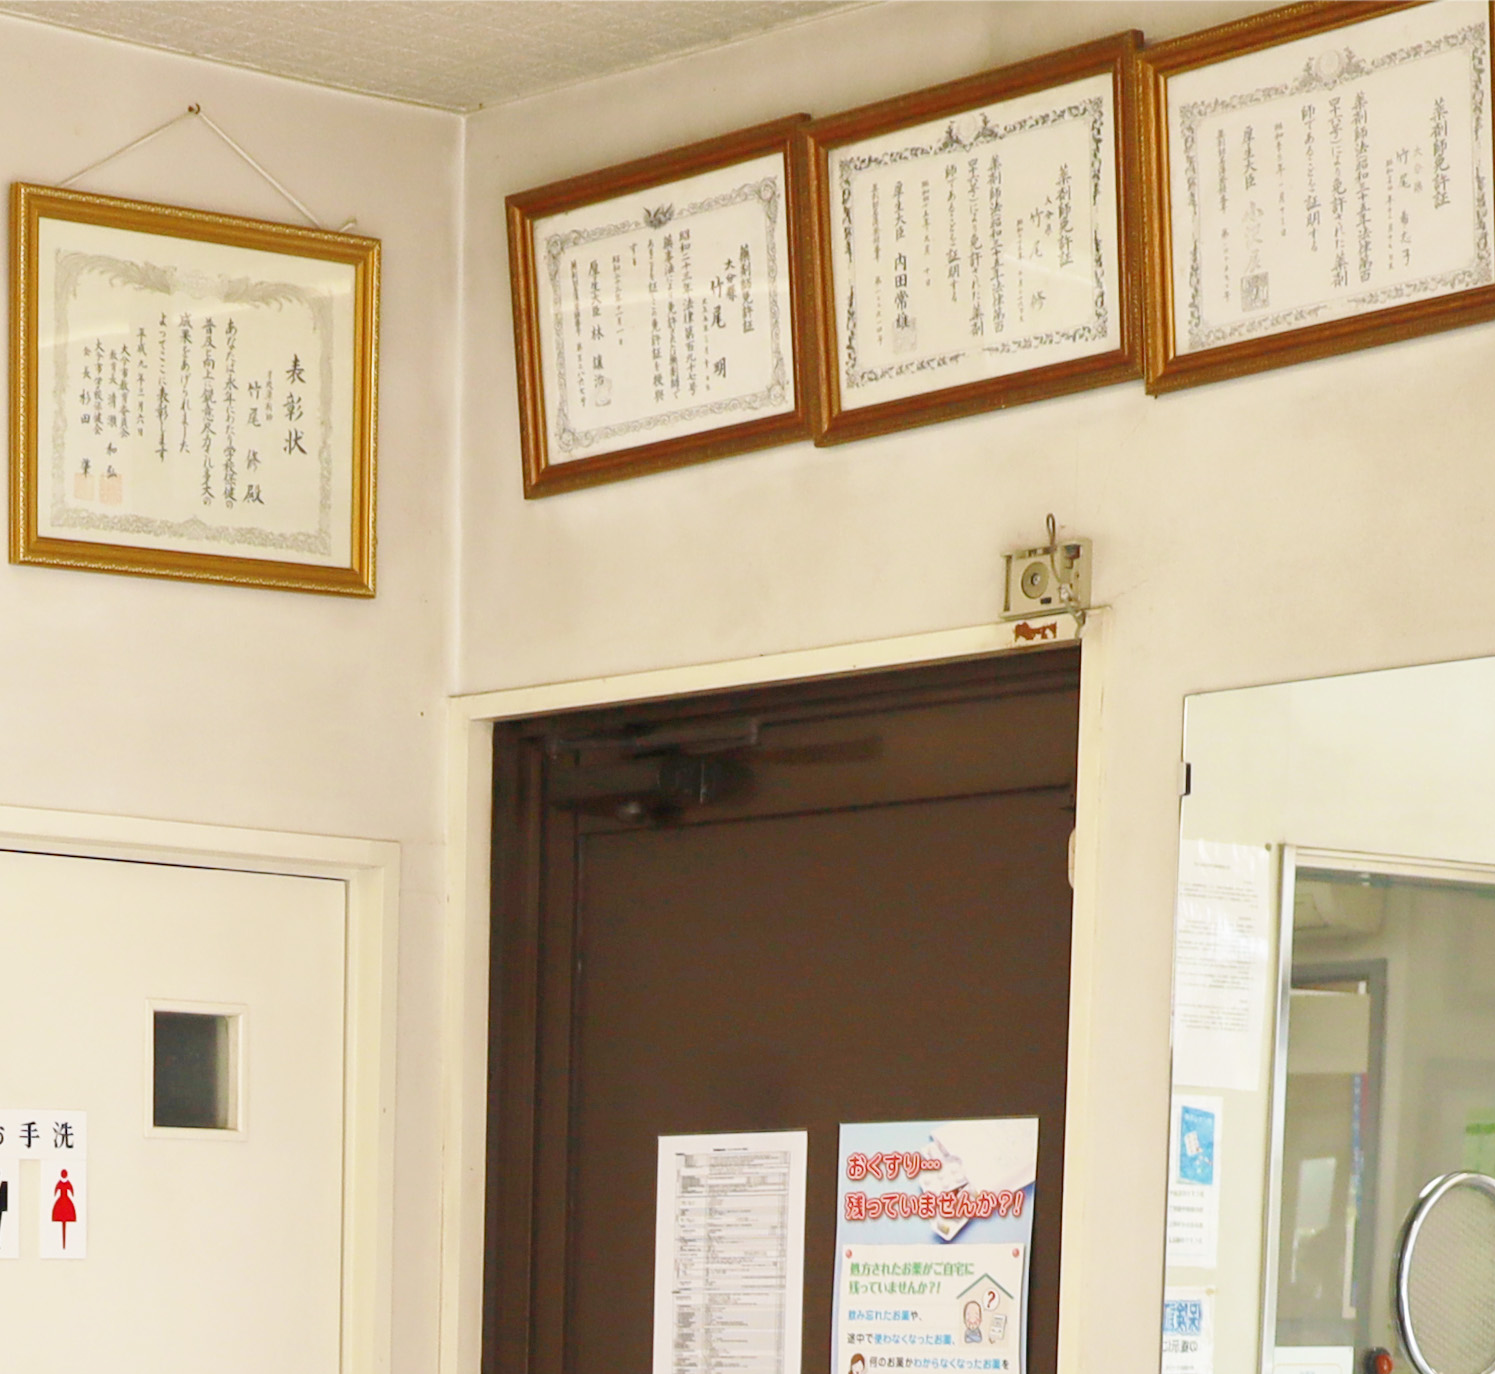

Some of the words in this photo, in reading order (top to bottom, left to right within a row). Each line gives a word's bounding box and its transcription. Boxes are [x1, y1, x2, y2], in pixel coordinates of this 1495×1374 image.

[283, 354, 308, 456] 表彰状
[849, 1260, 975, 1279] 処方されたお薬がご自宅に
[847, 1308, 923, 1322] 飲み忘れたお薬や、
[847, 1331, 957, 1347] 途中で使わなくなったお薬、
[868, 1356, 1010, 1372] 何のお薬かわからなくなったお薬を
